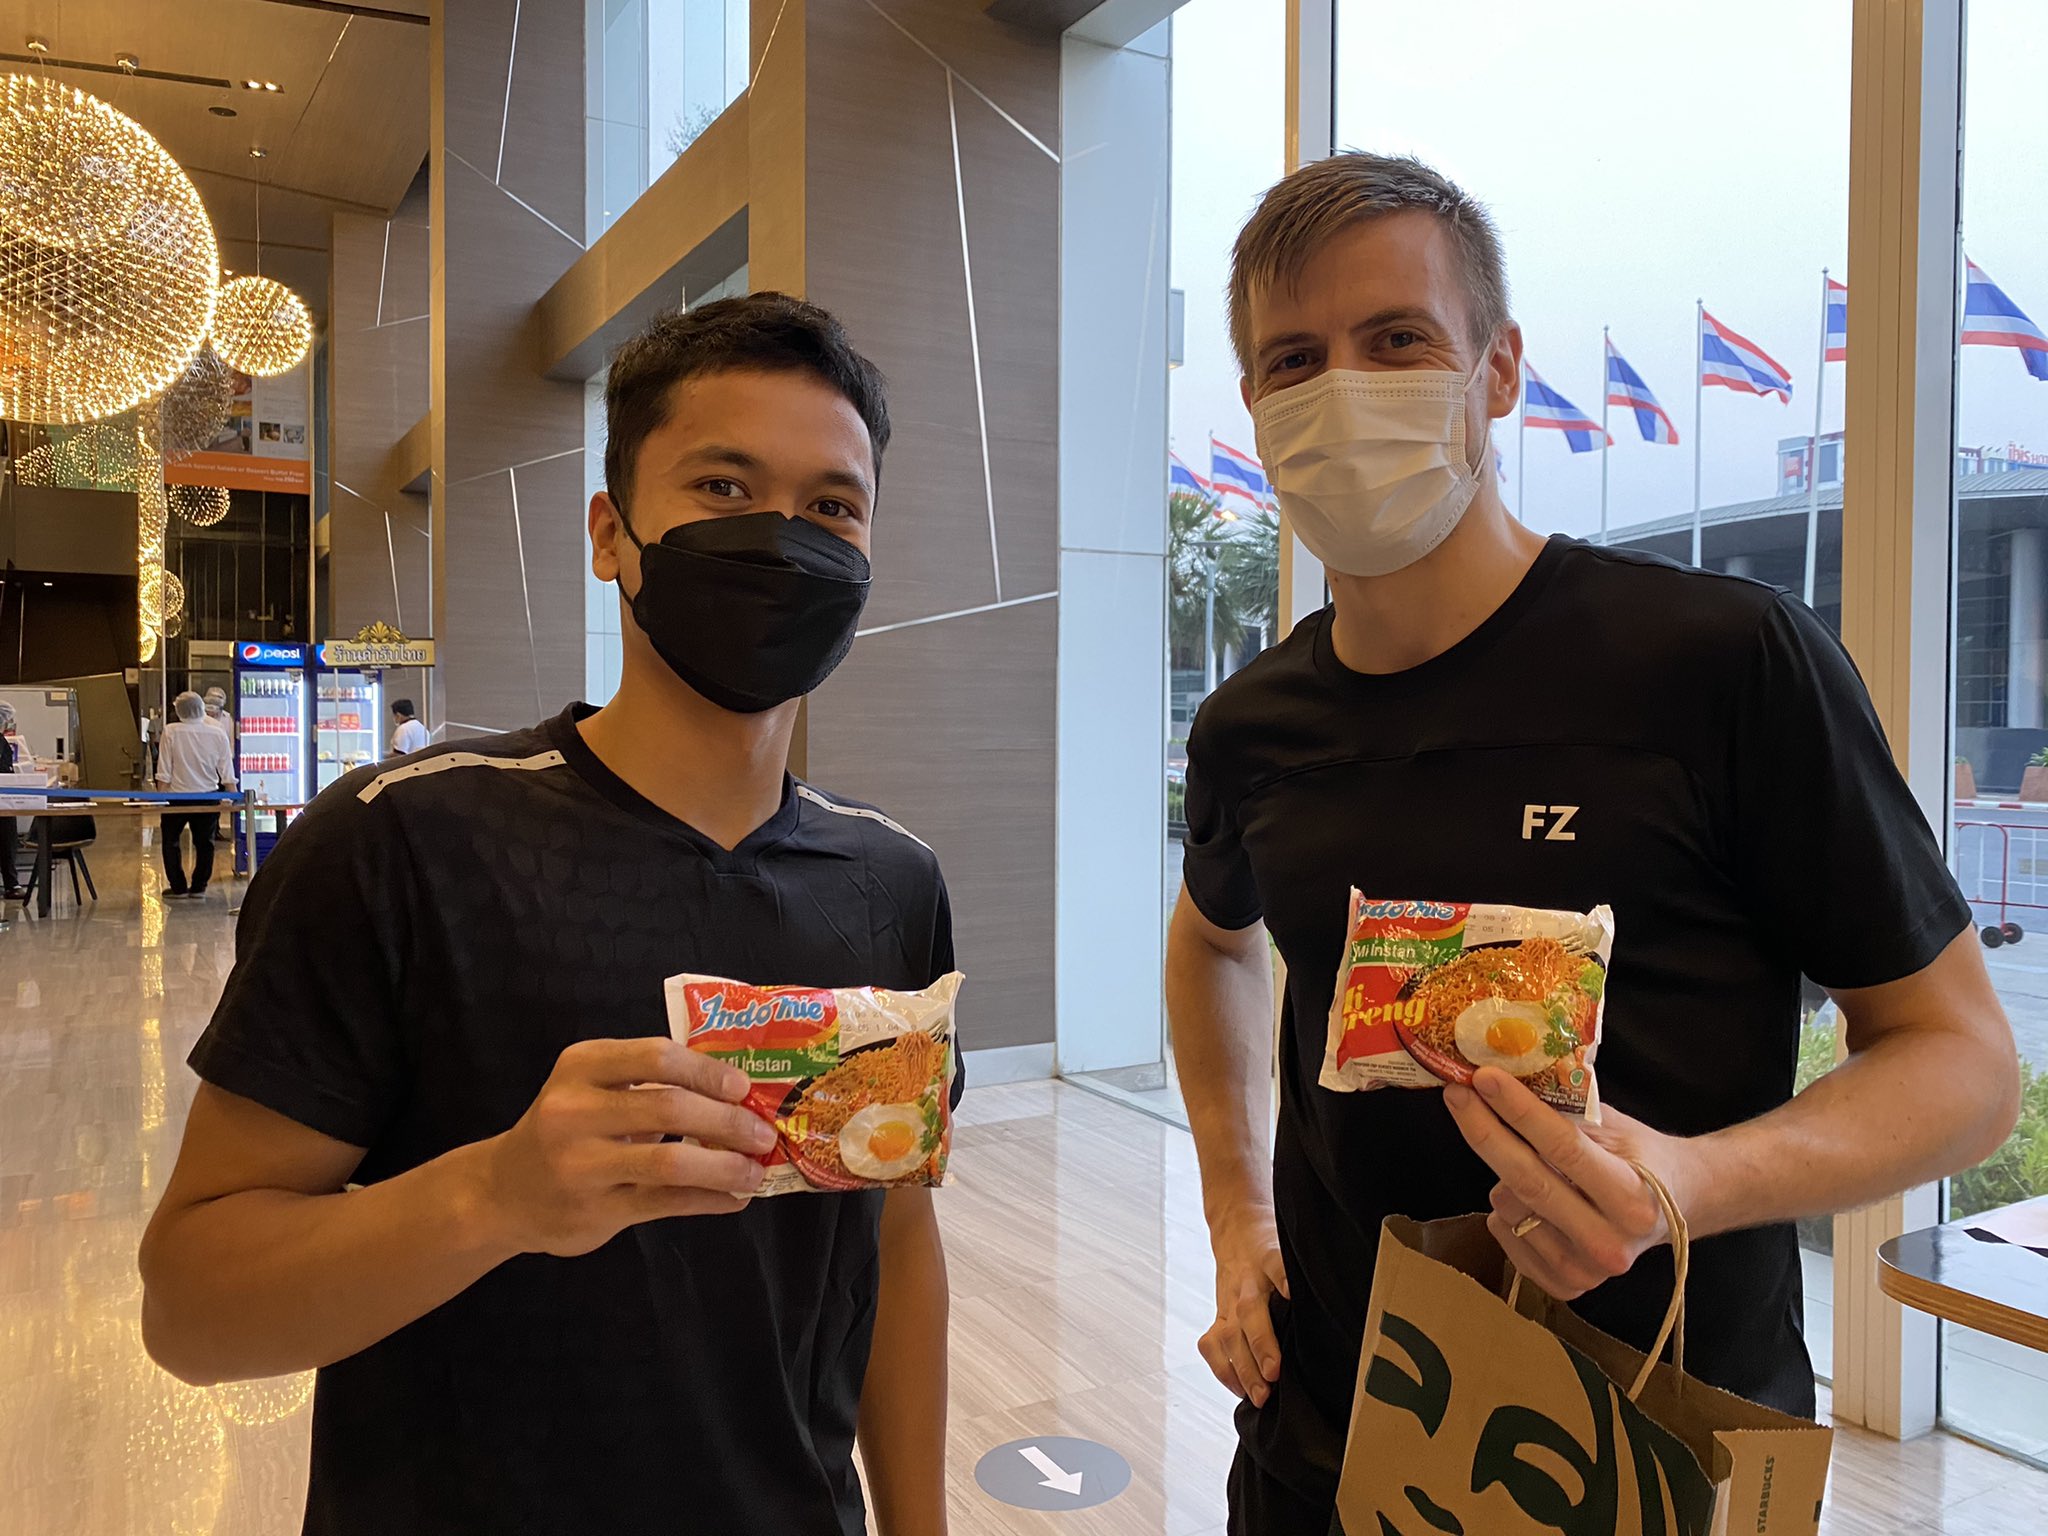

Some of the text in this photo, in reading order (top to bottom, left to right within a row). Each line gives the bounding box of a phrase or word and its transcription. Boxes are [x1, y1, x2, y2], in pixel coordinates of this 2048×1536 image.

[264, 648, 300, 659] pepsi
[1522, 804, 1580, 840] FZ
[1371, 943, 1416, 959] Instan
[689, 992, 824, 1038] Indomie
[1343, 999, 1426, 1031] reng
[742, 1056, 792, 1072] Instan
[1757, 1456, 1775, 1534] STARBUCKS
